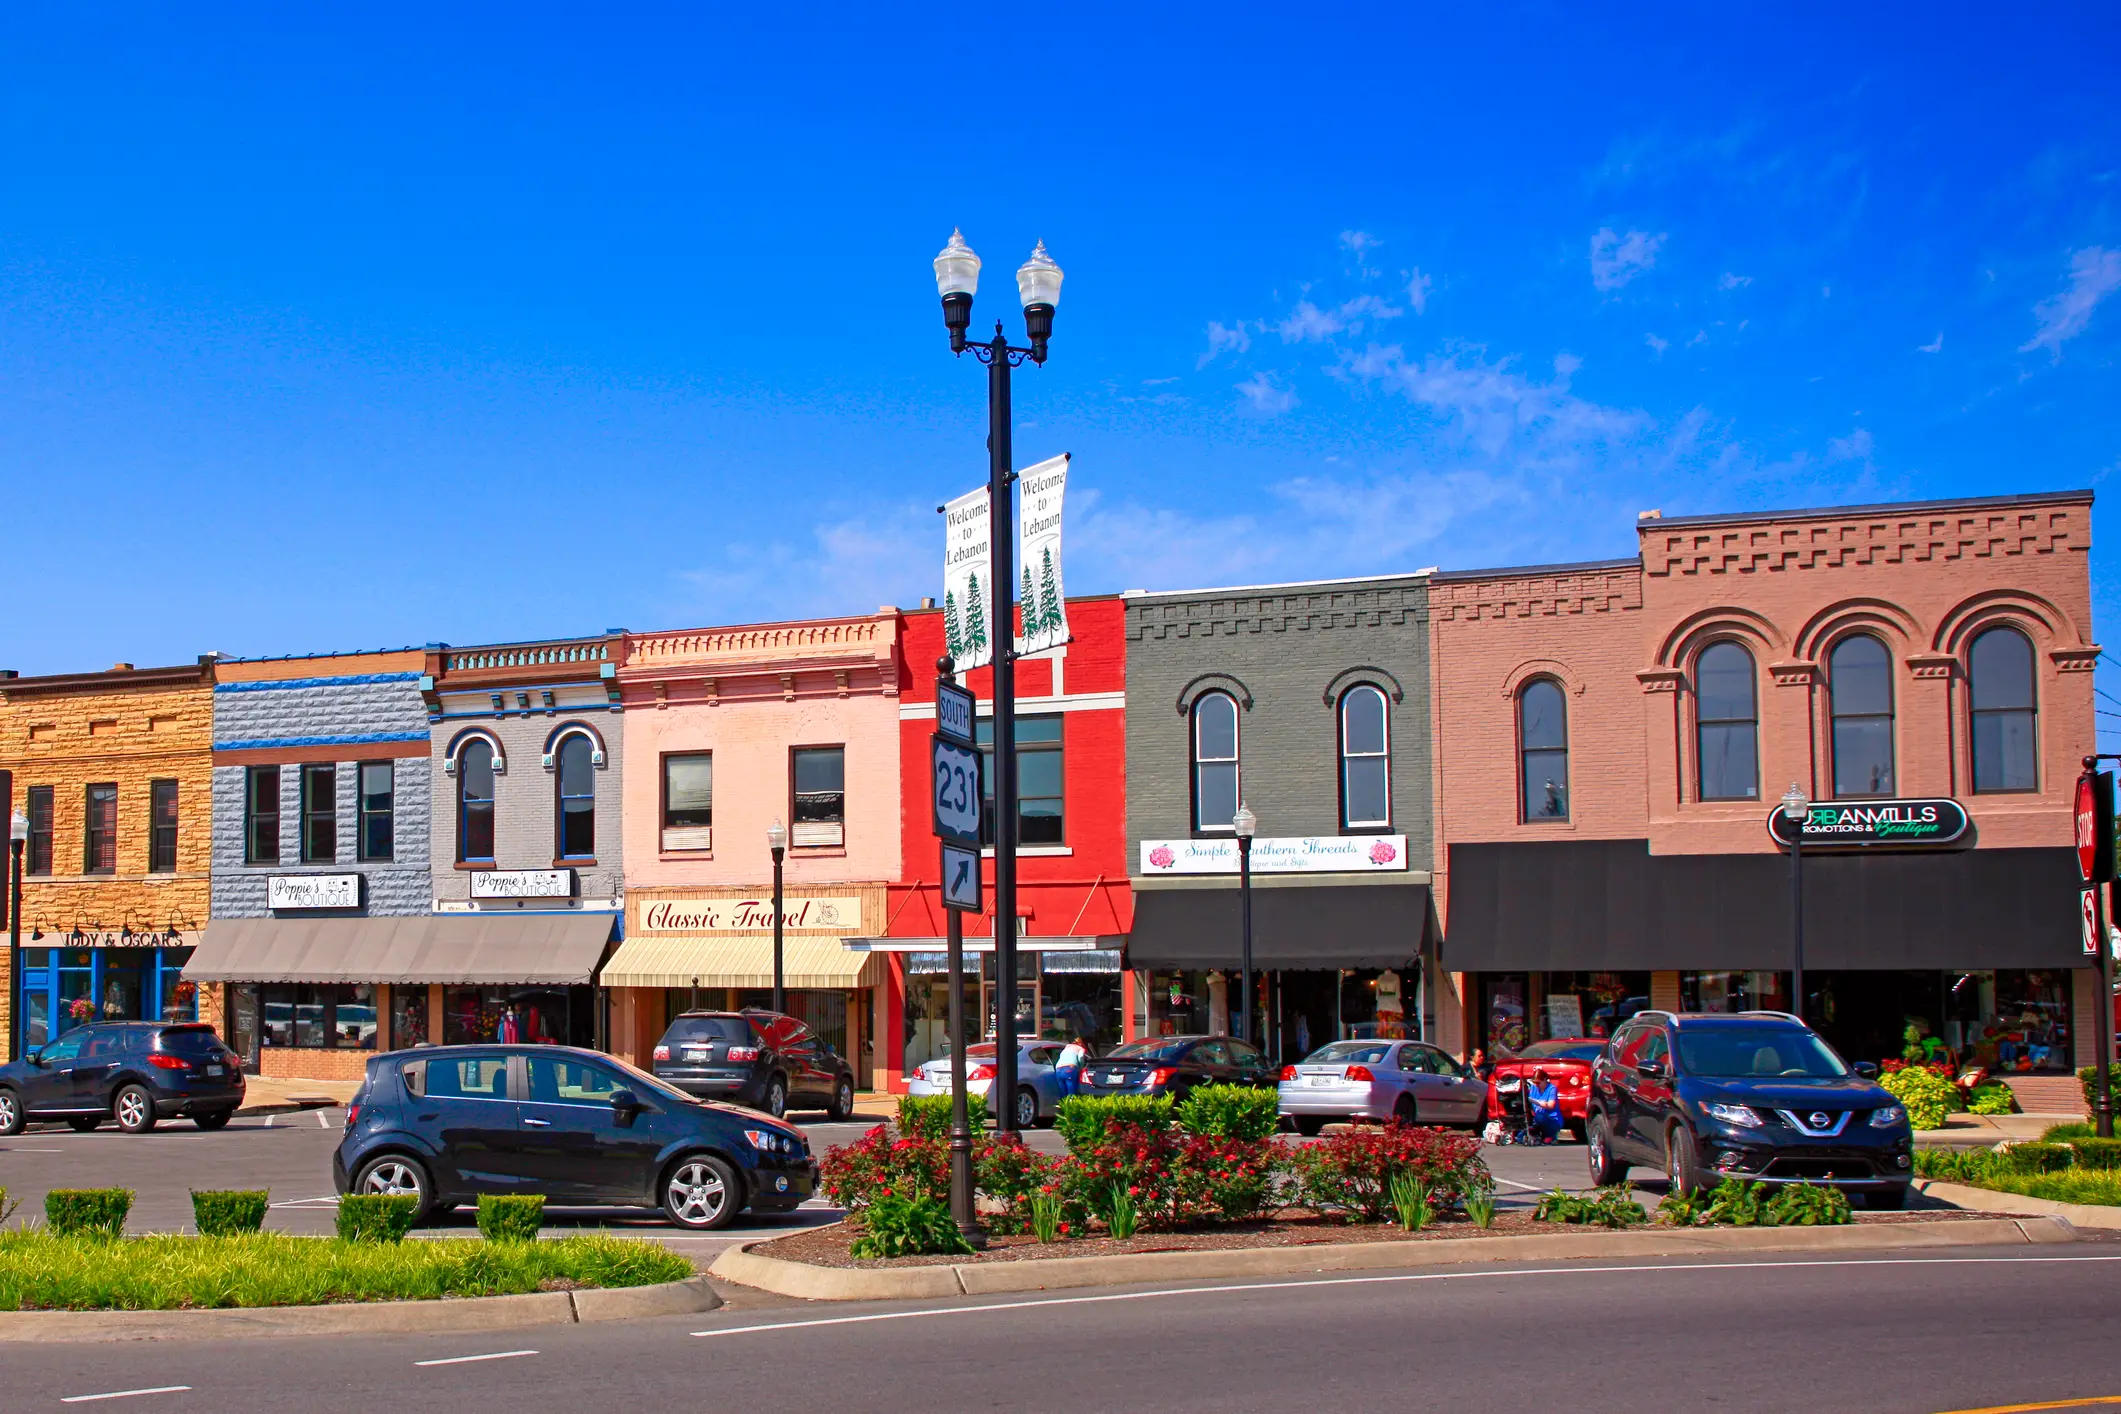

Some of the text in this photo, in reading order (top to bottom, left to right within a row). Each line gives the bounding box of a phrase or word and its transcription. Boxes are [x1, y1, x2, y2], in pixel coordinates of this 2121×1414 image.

[1022, 472, 1065, 497] Welcome
[948, 501, 988, 528] Welcome
[1037, 498, 1047, 511] to
[963, 528, 972, 540] to
[1023, 513, 1060, 538] Lebanon
[947, 541, 988, 565] Lebanon
[940, 697, 969, 729] SOUTH
[938, 760, 976, 817] 231
[1802, 819, 1939, 837] ROMOTIONS & Boutique
[2078, 811, 2092, 849] STOP
[1185, 841, 1231, 860] Simple
[1302, 839, 1358, 855] Threads
[1232, 858, 1269, 870] Btique
[274, 878, 320, 901] Poppie's
[477, 872, 527, 892] Poppie's
[504, 885, 562, 896] BOUTIQUE
[297, 893, 350, 906] BOUTIQUE
[647, 902, 720, 929] Classic
[65, 933, 183, 947] IDDY & OSCARS
